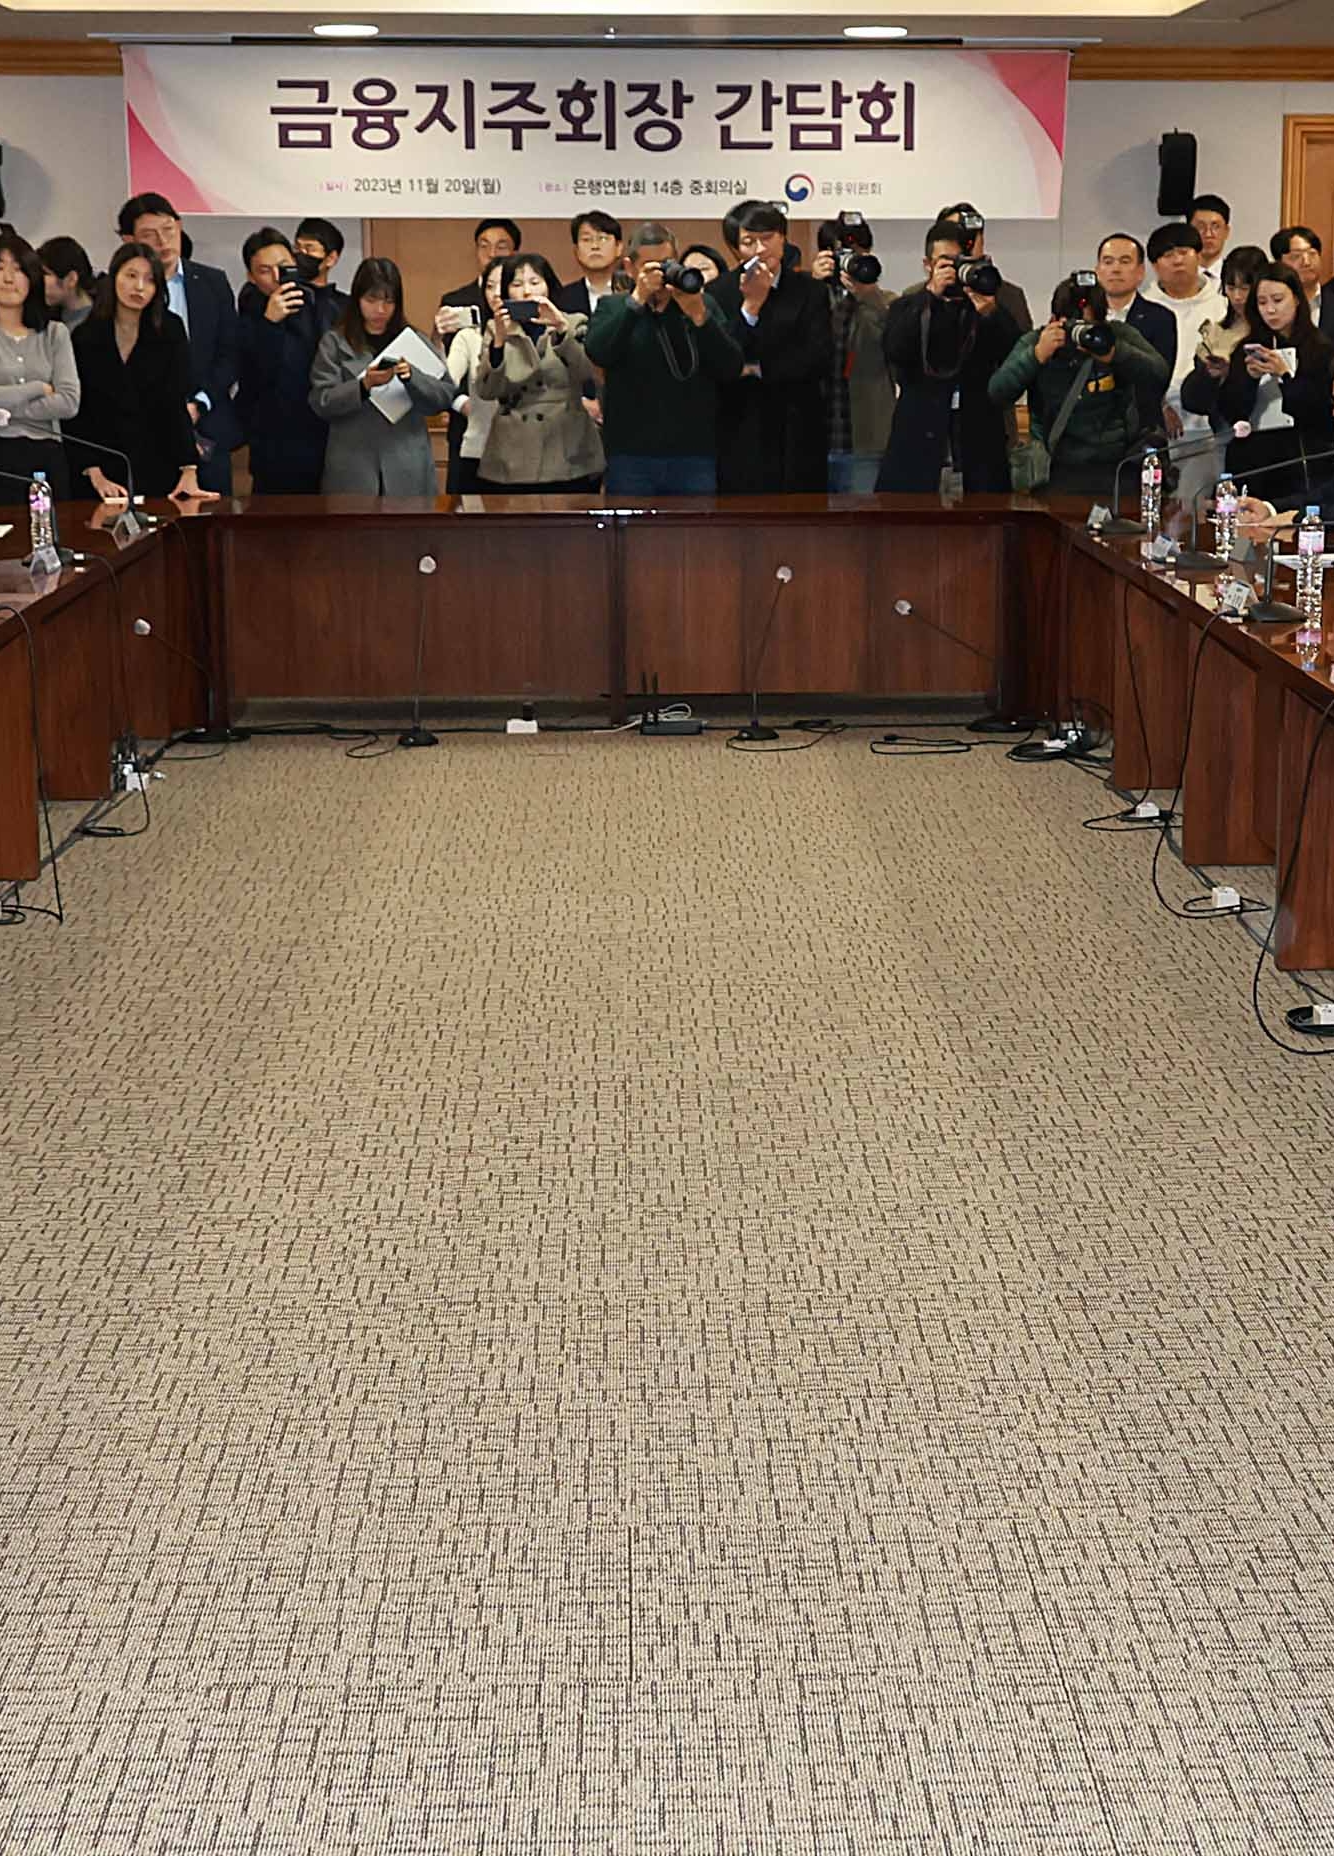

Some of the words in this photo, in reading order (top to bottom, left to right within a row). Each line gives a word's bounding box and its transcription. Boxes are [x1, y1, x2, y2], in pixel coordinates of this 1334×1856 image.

[270, 78, 694, 151] 금융지주회장
[715, 79, 915, 151] 간담회
[353, 178, 402, 195] 2023년
[408, 178, 440, 195] 11월
[445, 178, 502, 195] 20일(월)
[572, 178, 646, 196] 은행연합회
[652, 179, 684, 196] 14층
[689, 179, 748, 196] 중회의실
